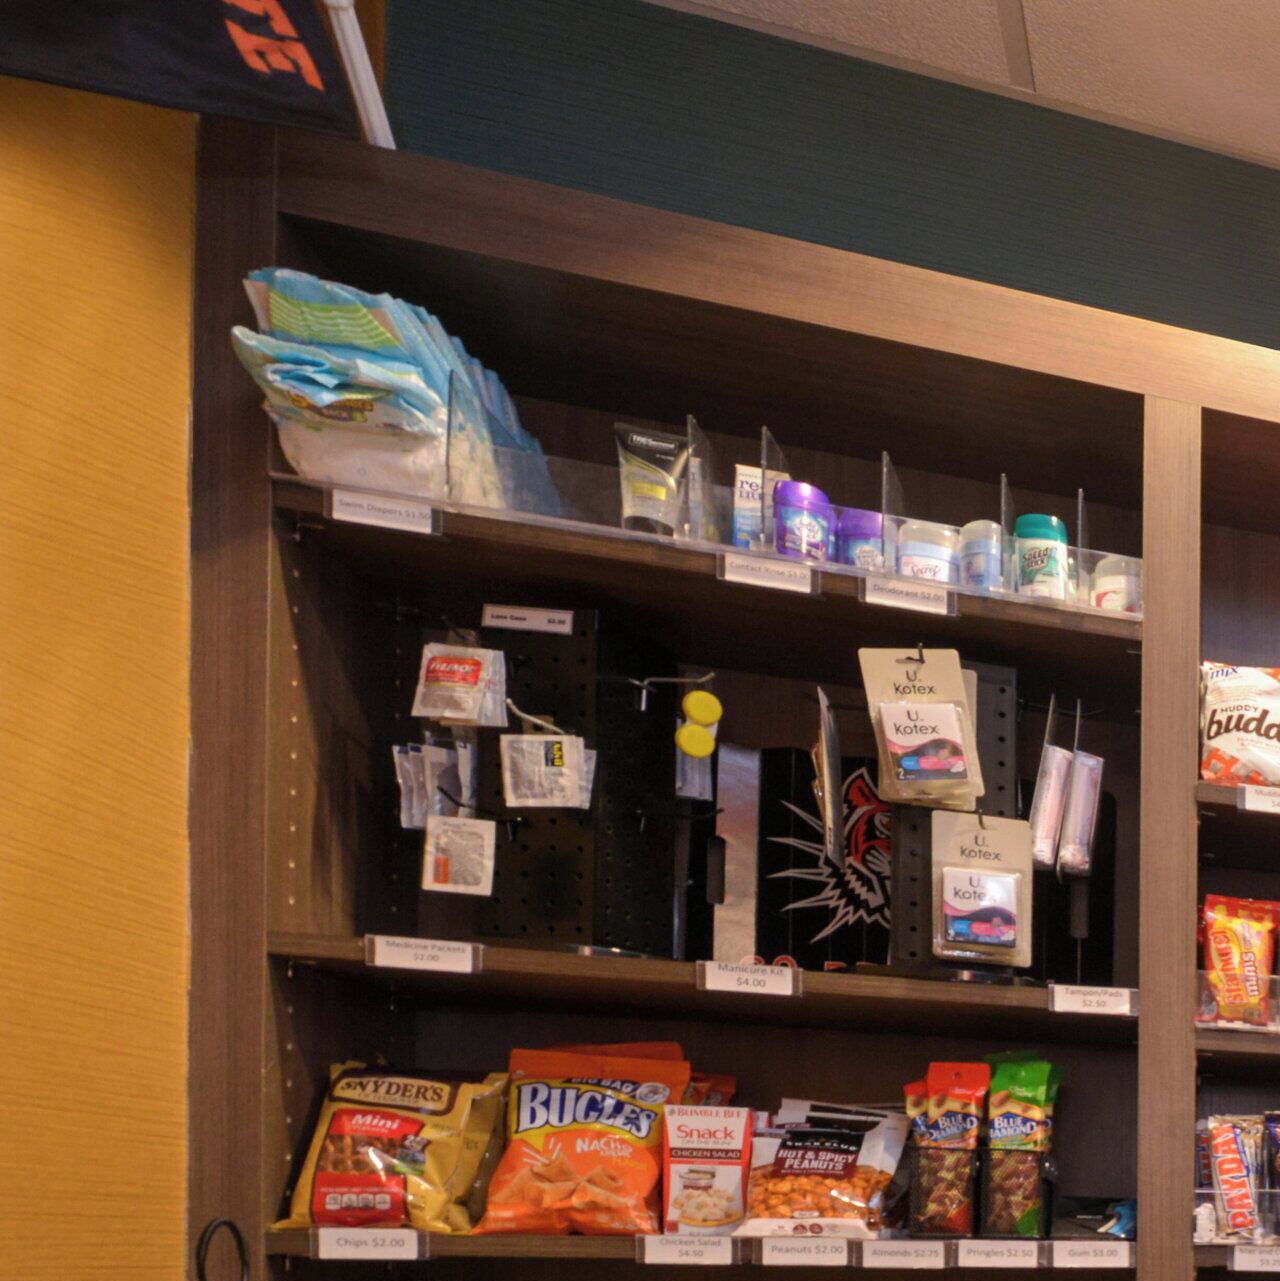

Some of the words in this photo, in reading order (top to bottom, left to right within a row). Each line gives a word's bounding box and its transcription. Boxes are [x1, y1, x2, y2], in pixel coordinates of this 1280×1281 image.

[338, 498, 365, 511] Swim
[366, 501, 403, 516] Diapers
[729, 560, 763, 573] Contact
[873, 582, 919, 600] Deodorant
[919, 590, 945, 602] $2.00
[1209, 665, 1240, 681] mix
[1220, 703, 1260, 714] MUDDY
[385, 939, 428, 953] Medicine
[430, 942, 466, 955] Packets
[717, 962, 766, 977] Manicure
[770, 966, 785, 977] Kit
[735, 977, 767, 990] $4.00
[340, 1079, 445, 1102] SNYDER'S
[514, 1081, 659, 1140] BUGLES
[677, 1107, 720, 1118] BUMBLE
[722, 1109, 742, 1119] BEE
[351, 1113, 401, 1131] Mini
[937, 1113, 965, 1128] BLUE
[993, 1115, 1024, 1128] BLUE
[676, 1124, 736, 1140] Snack
[928, 1117, 979, 1141] DIAMOND
[574, 1136, 634, 1154] NACHO
[671, 1149, 711, 1159] CHICKEN
[712, 1150, 741, 1160] SALAD
[778, 1149, 803, 1161] HOT
[804, 1151, 814, 1161] &
[816, 1150, 855, 1164] SPICY
[784, 1157, 845, 1171] PEANUTS
[1211, 1123, 1256, 1233] PAYDAY
[336, 1235, 369, 1250] Chips
[371, 1235, 406, 1250] $2.00
[659, 1236, 695, 1248] Chicken
[696, 1237, 722, 1248] Salad
[770, 1243, 813, 1256] Peanuts
[814, 1244, 844, 1256] $2.00
[677, 1248, 704, 1259] $4.50
[871, 1247, 911, 1259] Almonds
[912, 1248, 940, 1259] $2.75
[966, 1247, 1005, 1261] Pringles
[1005, 1247, 1034, 1259] $2.50
[1067, 1247, 1090, 1259] Gum
